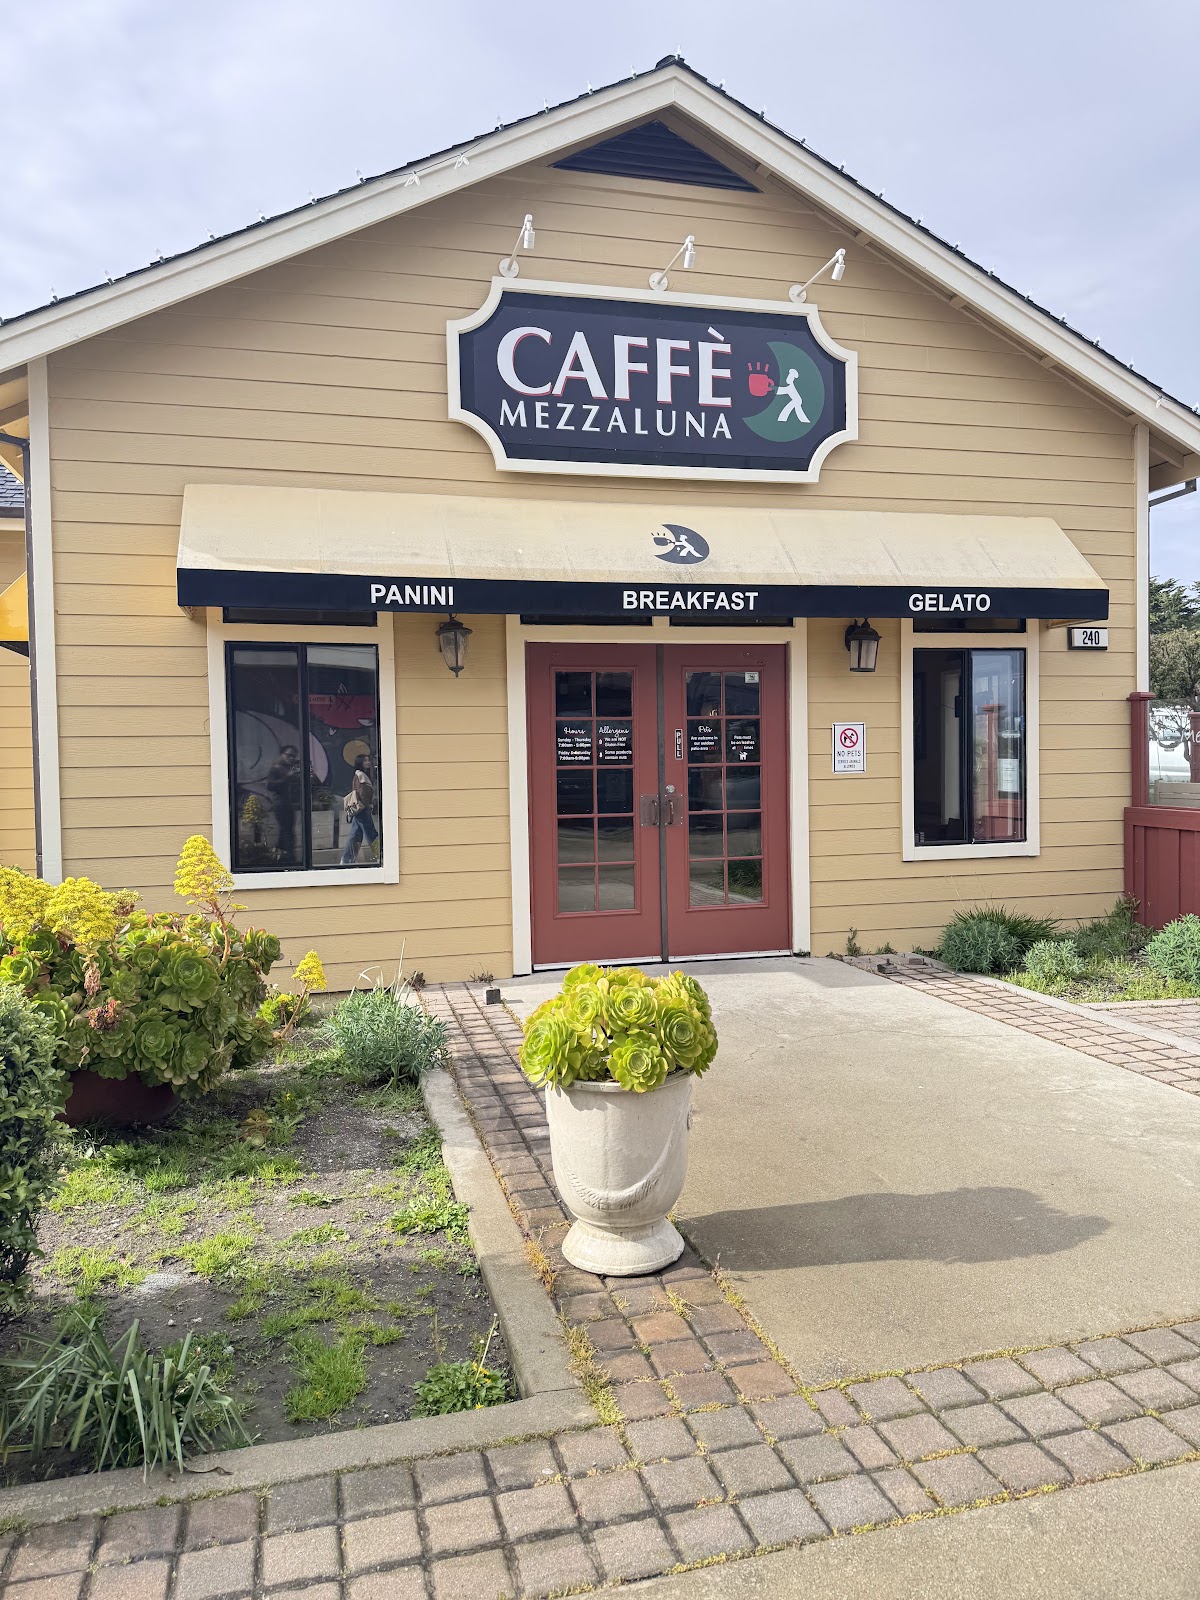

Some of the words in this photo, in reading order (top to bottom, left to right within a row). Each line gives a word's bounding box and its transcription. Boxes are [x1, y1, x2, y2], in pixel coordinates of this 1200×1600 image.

[497, 326, 732, 408] CAFFÈ
[499, 399, 733, 440] MEZZALUNA
[370, 583, 454, 606] PANINI
[622, 590, 759, 611] BREAKFAST
[908, 593, 991, 612] GELATO
[1082, 630, 1100, 646] 240
[563, 726, 586, 735] Hours
[598, 725, 629, 738] Allergens
[698, 725, 713, 733] Pets
